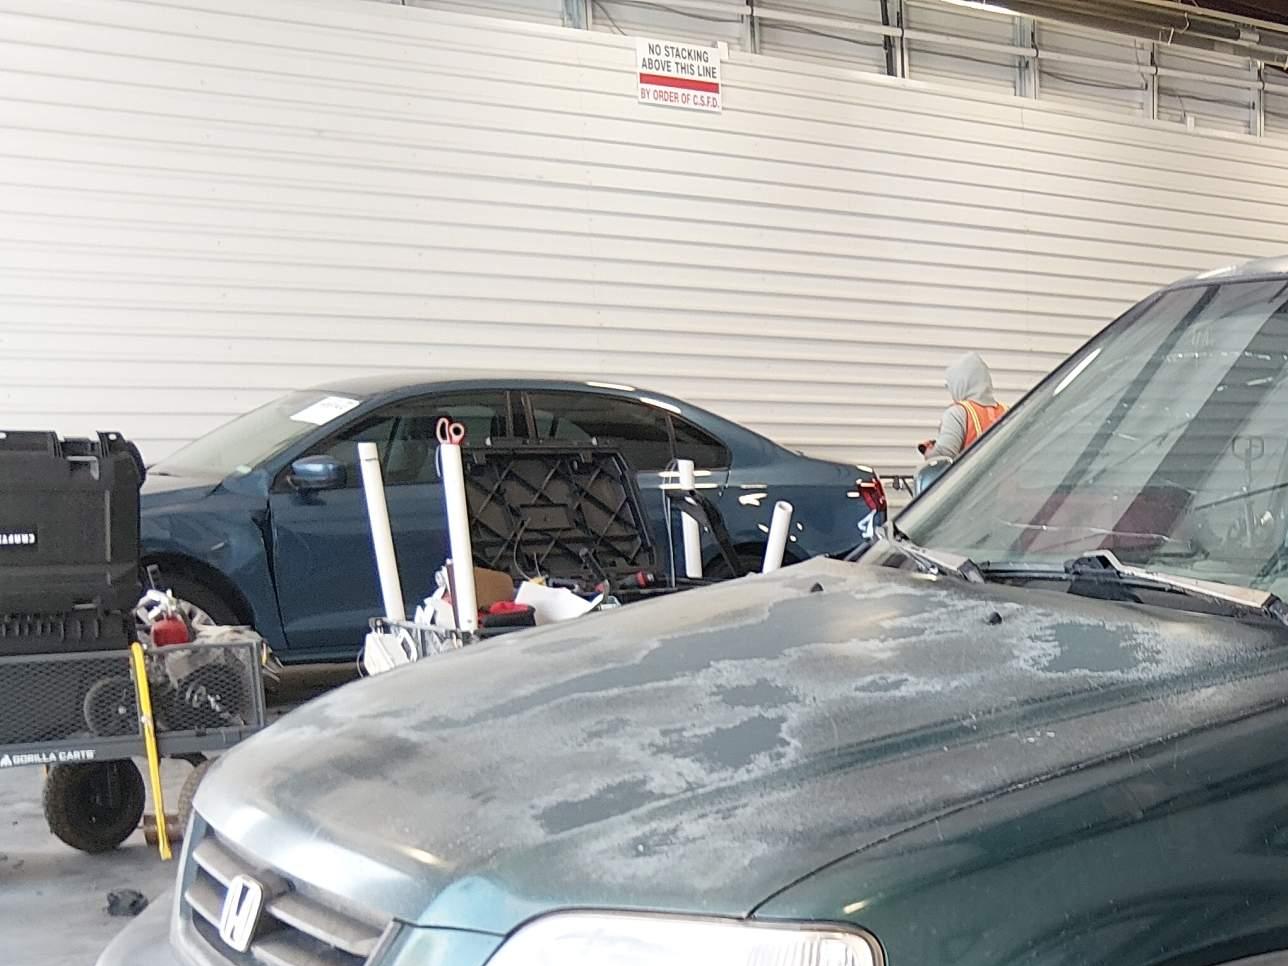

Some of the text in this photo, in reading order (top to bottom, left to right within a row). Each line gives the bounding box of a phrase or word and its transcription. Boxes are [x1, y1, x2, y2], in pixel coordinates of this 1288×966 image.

[648, 43, 709, 63] NO STACKING
[641, 57, 717, 79] ABOVE THIS LINE
[641, 88, 720, 108] BY ORDER OF C.S.F.D.
[12, 752, 57, 765] GORILLA
